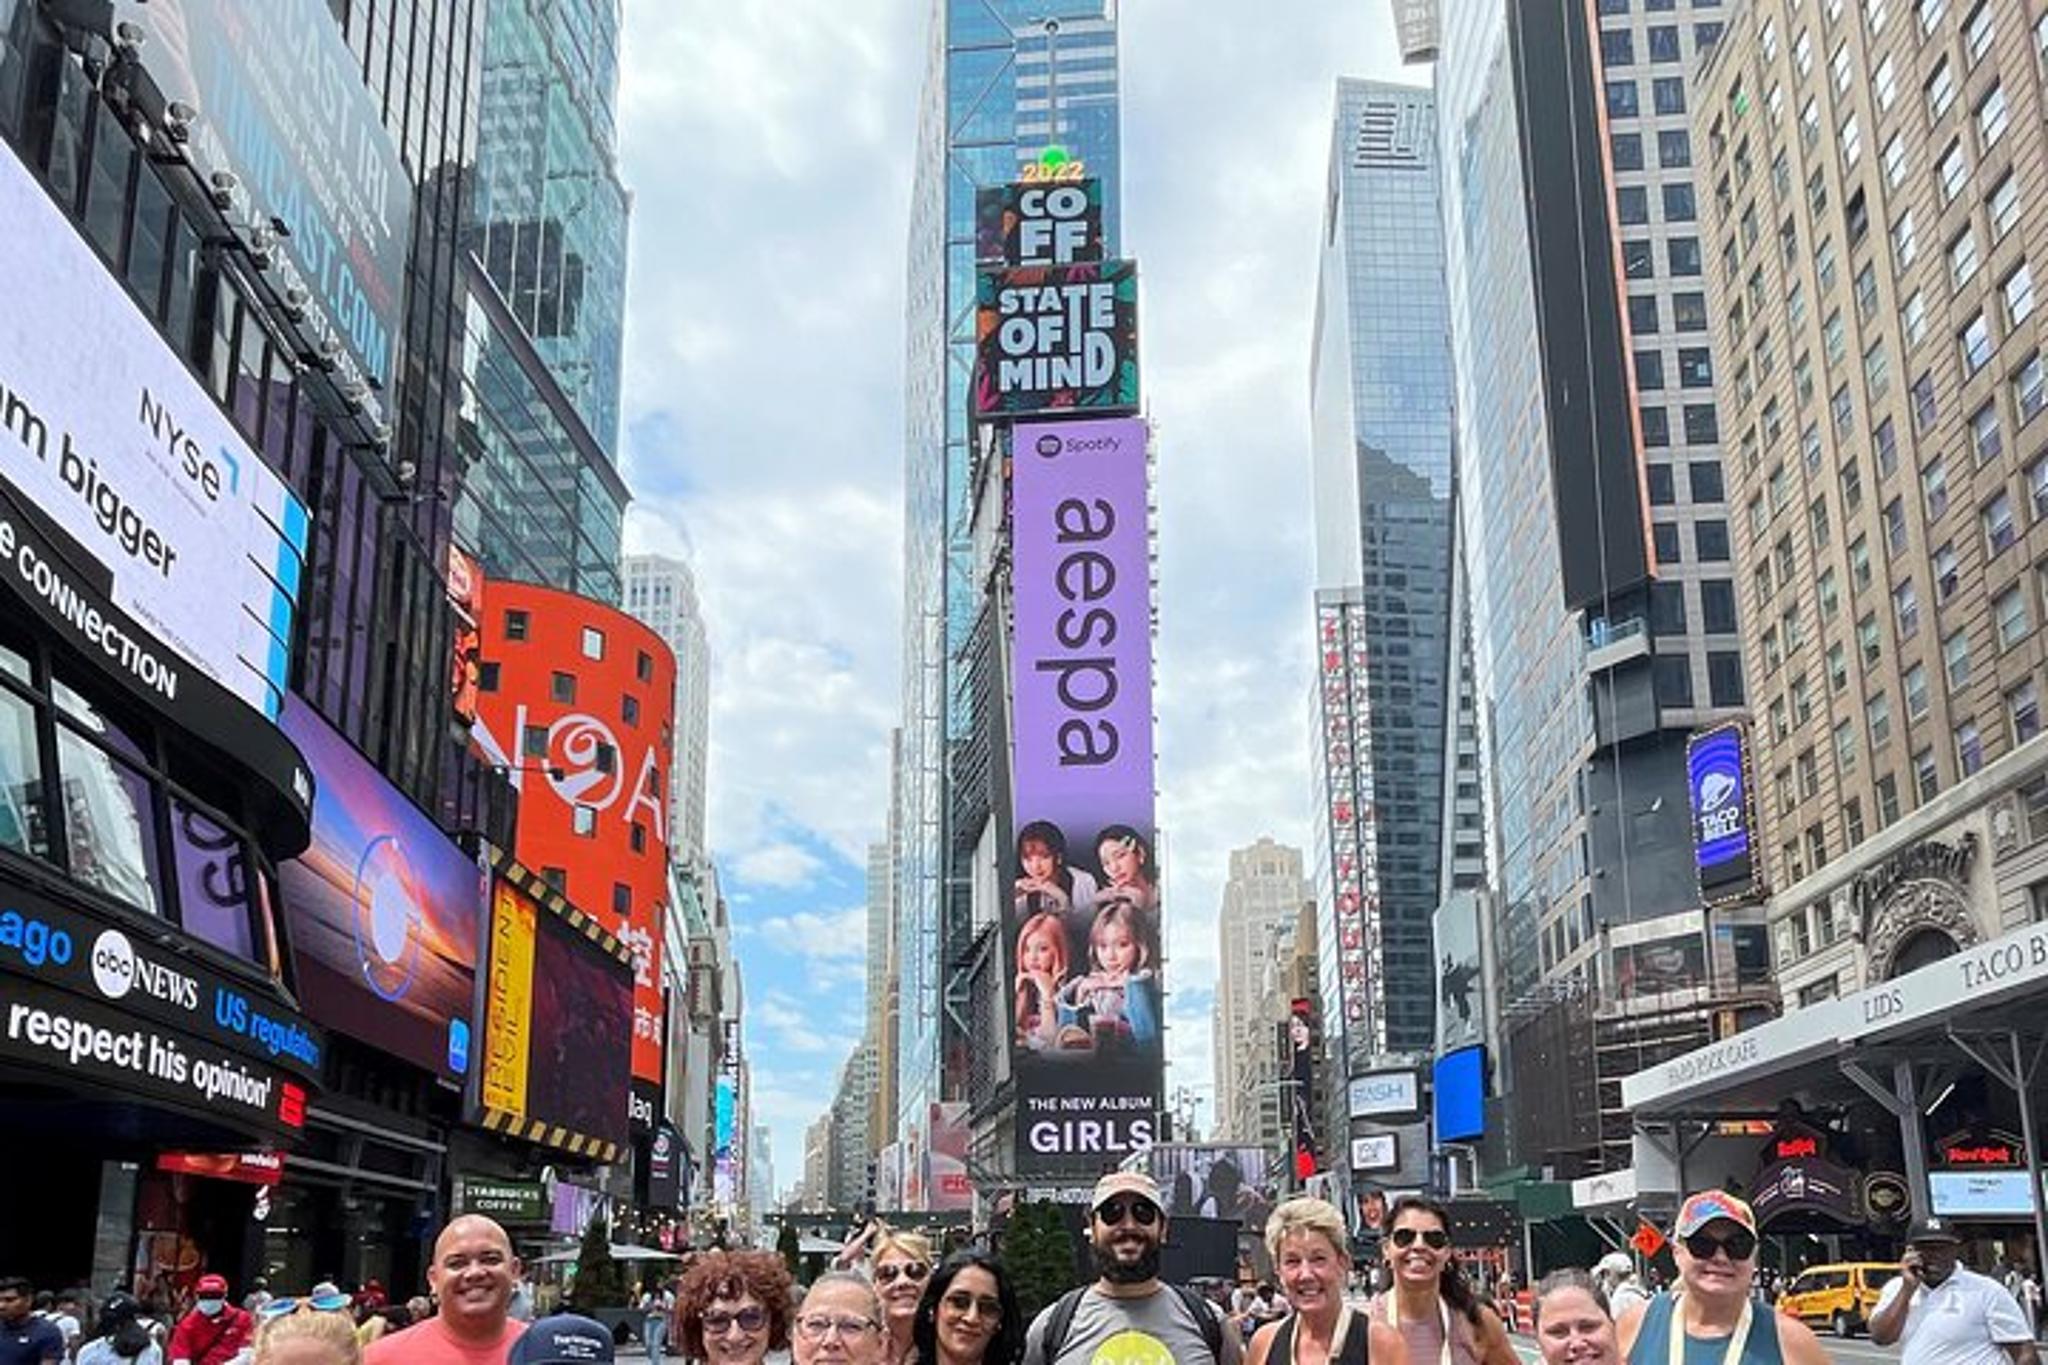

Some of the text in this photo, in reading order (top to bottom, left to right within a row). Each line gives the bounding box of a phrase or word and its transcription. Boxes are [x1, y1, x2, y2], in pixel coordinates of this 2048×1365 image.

[1023, 162, 1085, 183] 2022
[1020, 188, 1088, 219] CO
[999, 315, 1064, 355] OF
[1000, 283, 1115, 352] STATE
[999, 331, 1115, 391] MIND
[1066, 437, 1121, 453] Spotify
[59, 432, 176, 578] bigger
[1035, 498, 1119, 766] aespa
[1700, 806, 1738, 829] TACO
[0, 911, 72, 967] ago
[133, 956, 198, 1010] NEWS
[1961, 944, 2023, 988] TACO
[216, 989, 247, 1033] US
[1863, 989, 1904, 1024] LIDS
[8, 1003, 271, 1109] respect his opinion'
[1028, 1096, 1153, 1111] THE NEW ALBUM
[1029, 1119, 1153, 1153] GIRLS
[466, 1186, 539, 1200] STARBUCKS
[476, 1200, 522, 1211] COFFEE
